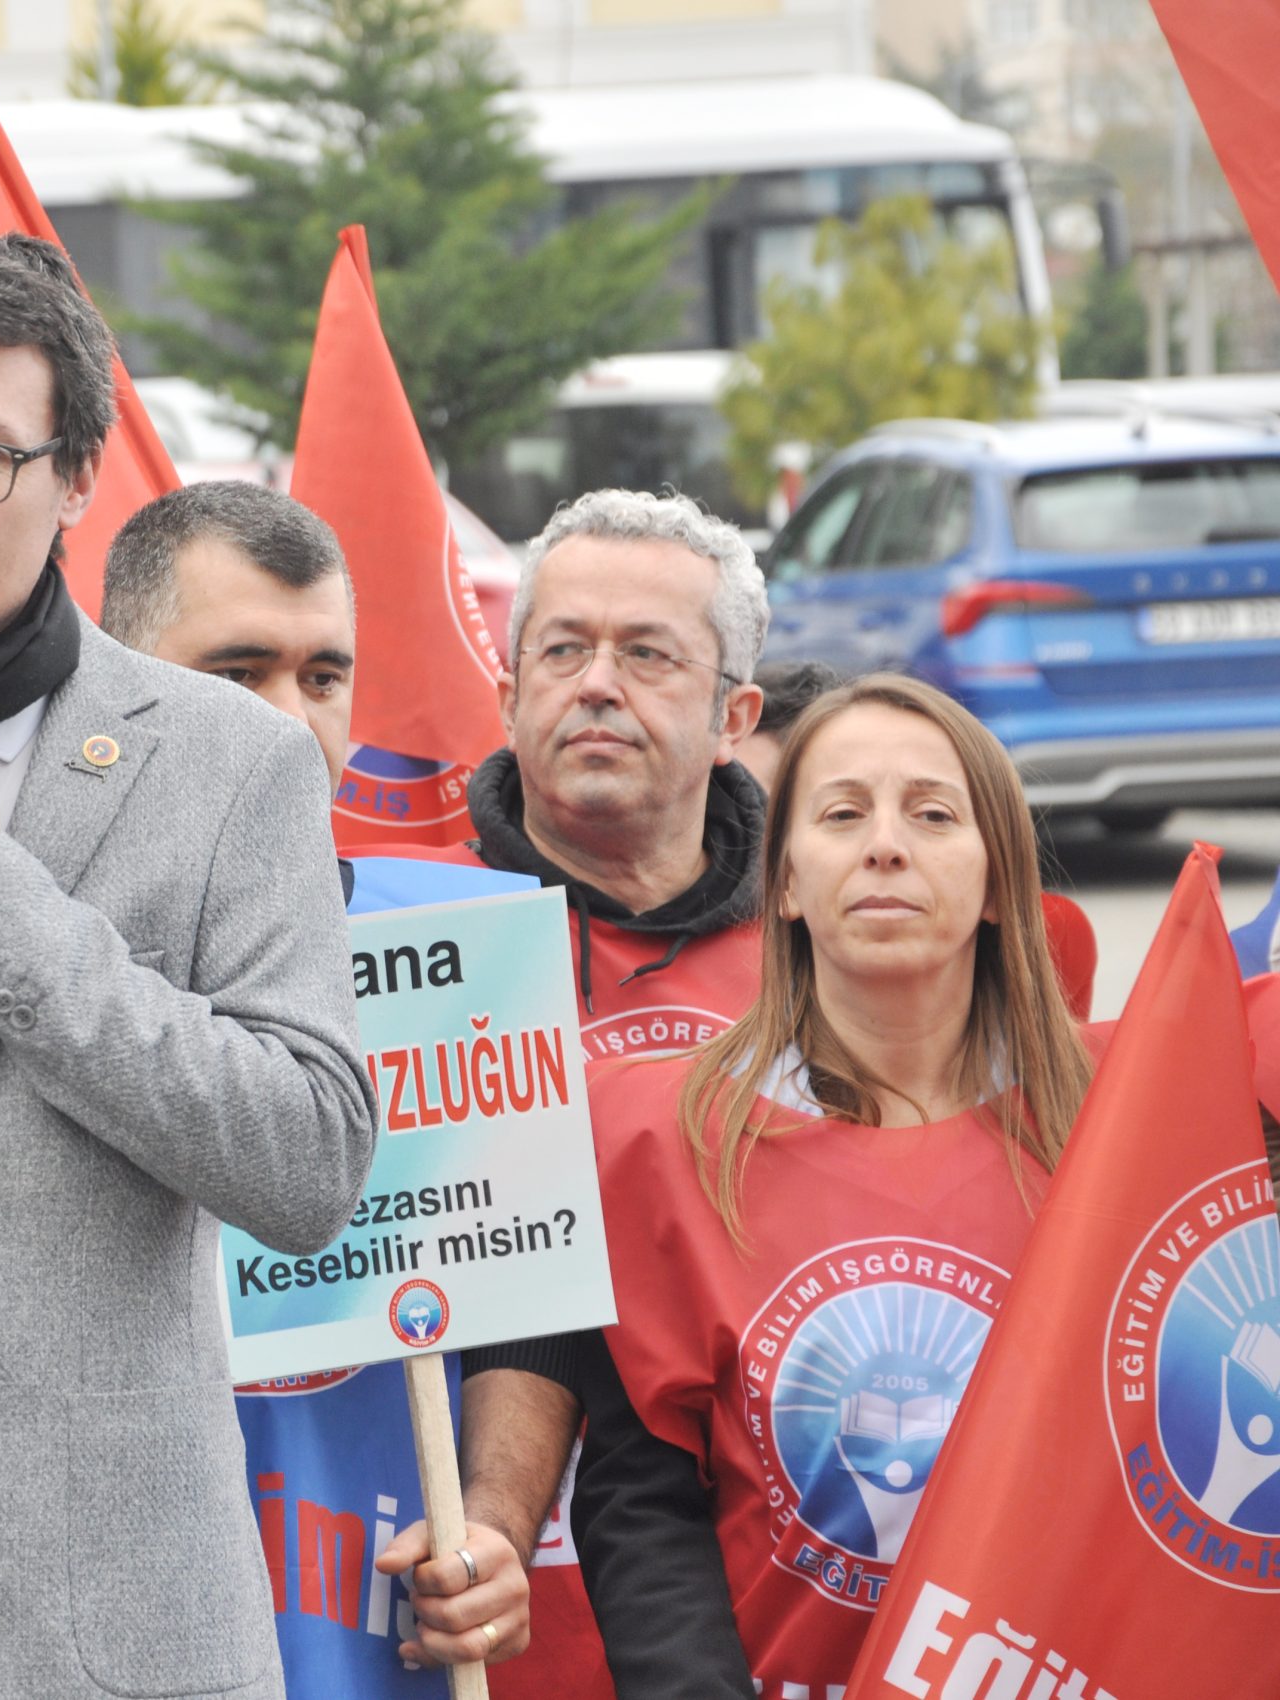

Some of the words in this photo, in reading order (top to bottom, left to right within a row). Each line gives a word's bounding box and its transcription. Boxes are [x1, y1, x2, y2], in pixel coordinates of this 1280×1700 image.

[353, 939, 464, 999] ana
[349, 1179, 493, 1228] ezasını
[237, 1234, 423, 1297] Kesebilir
[438, 1209, 577, 1266] misin?
[826, 1248, 998, 1308] İŞGÖRENL
[756, 1277, 824, 1358] BİLİM
[1116, 1268, 1167, 1402] EĞİTİM
[1158, 1221, 1199, 1263] VE
[746, 1364, 767, 1400] VE
[872, 1373, 929, 1392] 2005
